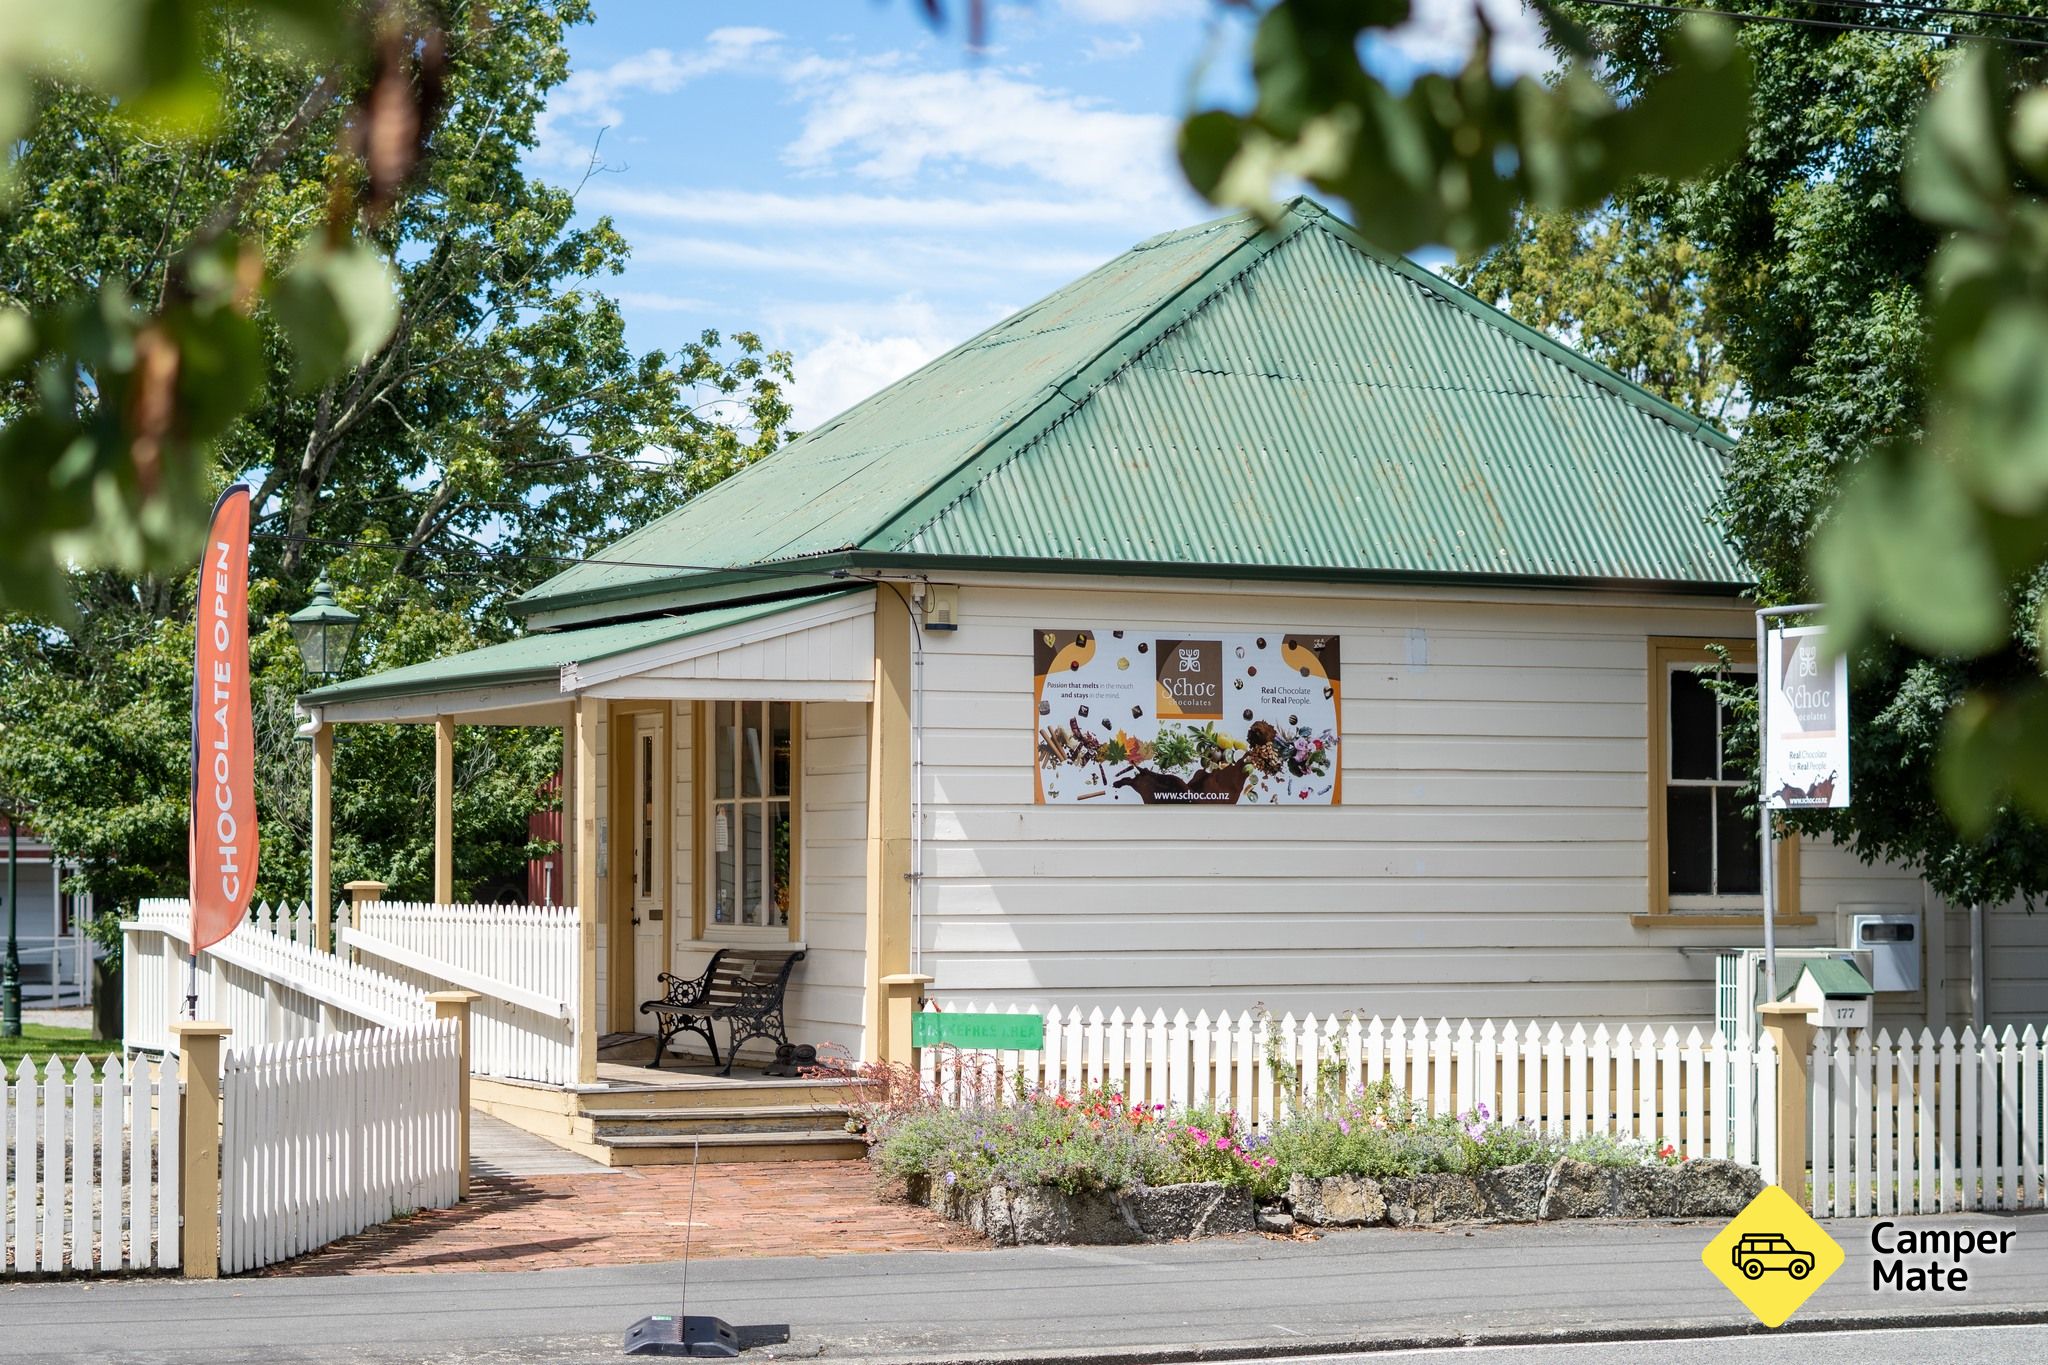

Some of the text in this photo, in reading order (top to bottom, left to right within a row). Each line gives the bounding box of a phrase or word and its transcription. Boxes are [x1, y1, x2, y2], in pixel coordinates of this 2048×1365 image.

[1162, 677, 1216, 699] Schoc
[1261, 686, 1311, 695] Real Chocolate
[1074, 692, 1089, 700] stays
[1261, 696, 1271, 704] for
[1272, 696, 1287, 704] Real
[1785, 685, 1830, 709] Schoc
[1797, 711, 1827, 721] ocolates
[214, 541, 240, 903] CHOCOLATE OPEN
[1788, 750, 1801, 759] Real
[1797, 761, 1809, 770] Real
[1154, 789, 1230, 800] www.schoc.co.nz
[1837, 1007, 1855, 1019] 177
